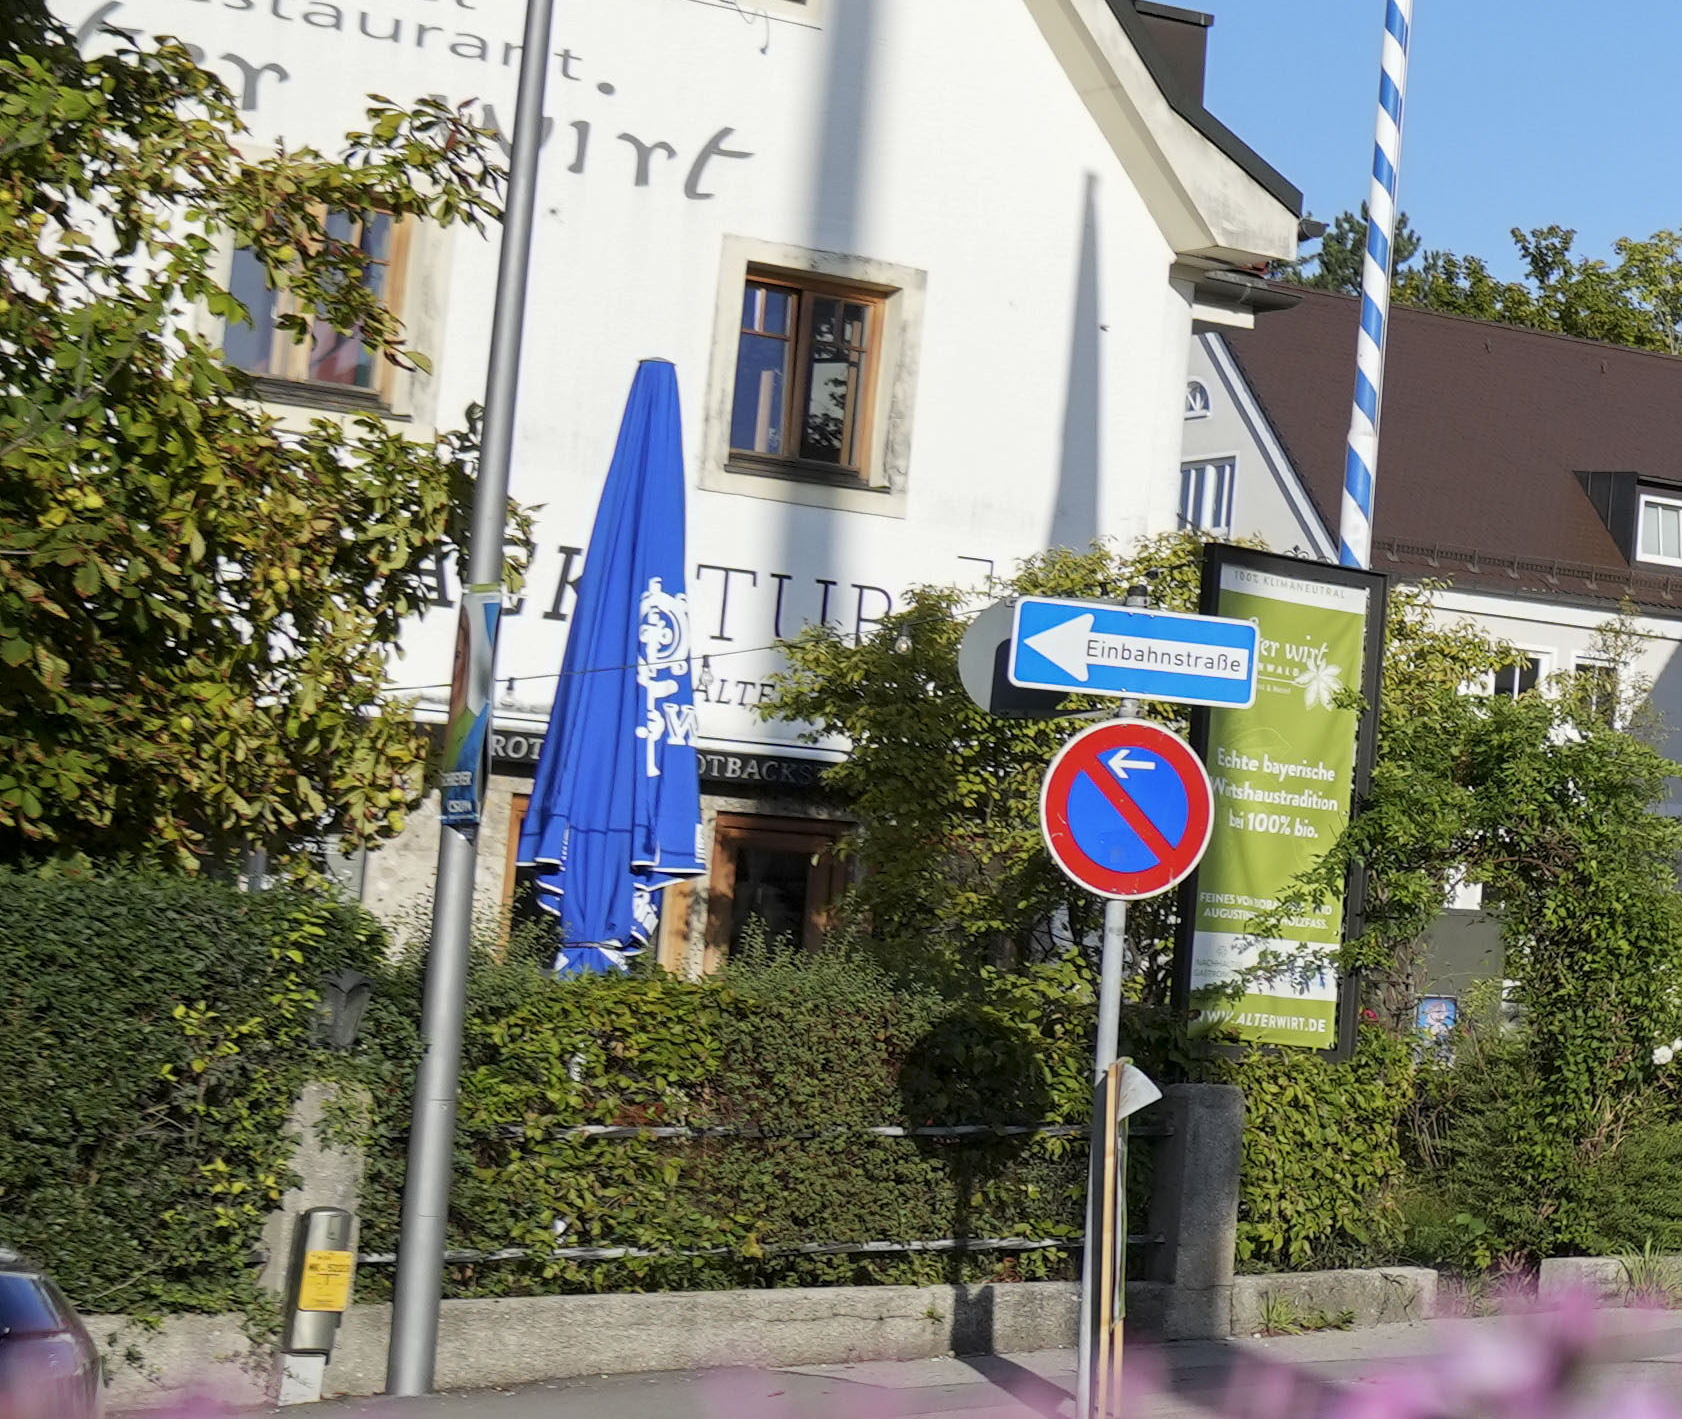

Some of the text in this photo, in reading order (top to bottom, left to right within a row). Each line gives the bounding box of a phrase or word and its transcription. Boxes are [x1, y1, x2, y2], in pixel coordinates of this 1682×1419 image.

[1263, 575, 1346, 600] KLIMANEUTRAL
[1086, 638, 1241, 673] Einbahnstraße
[1216, 746, 1336, 782] Echte bayerische
[1211, 775, 1339, 812] Wirtshaustradition
[1228, 808, 1320, 839] bei 100% bio.
[1200, 892, 1236, 905] FEINES
